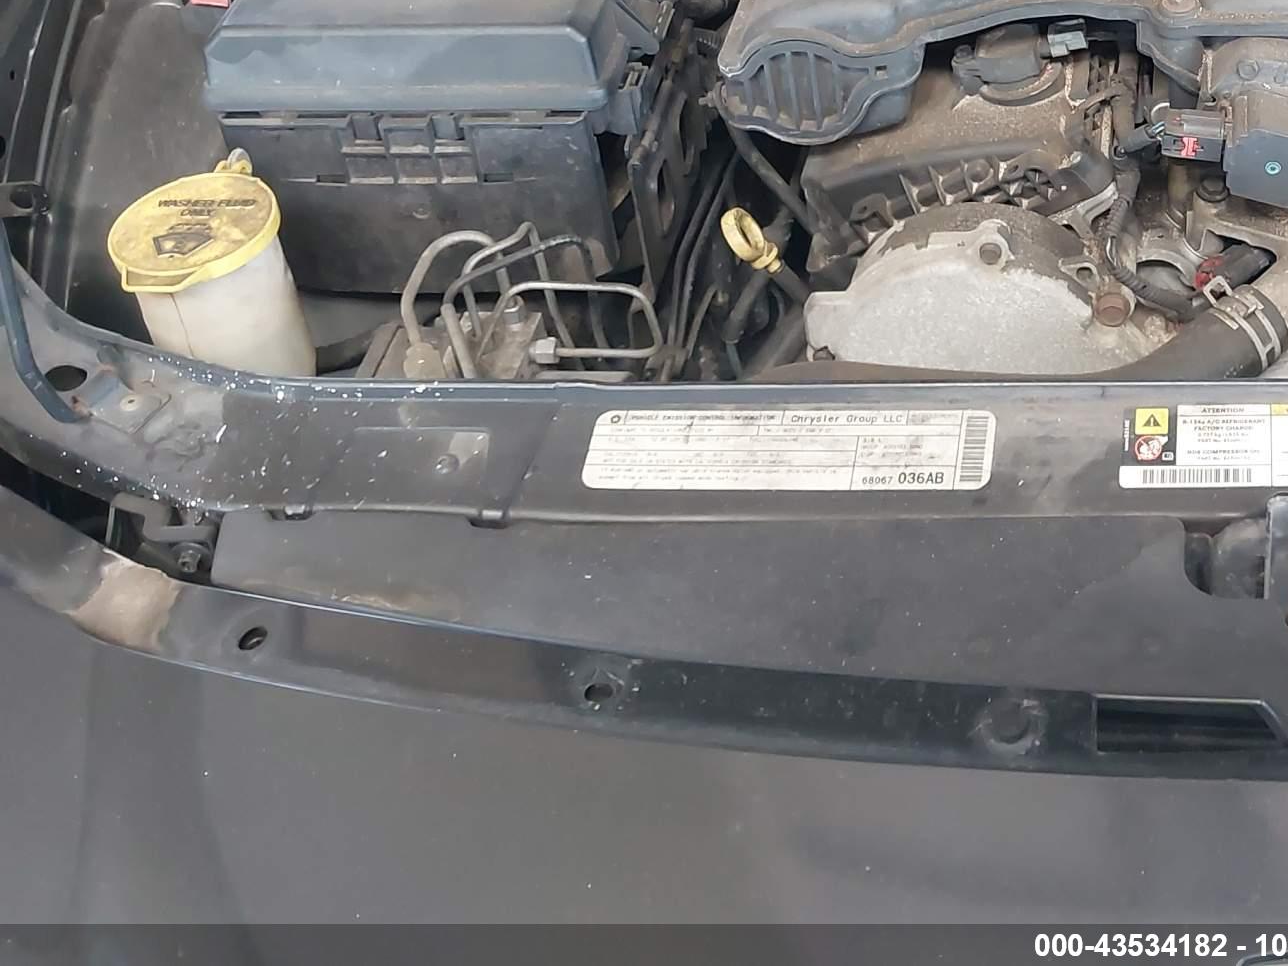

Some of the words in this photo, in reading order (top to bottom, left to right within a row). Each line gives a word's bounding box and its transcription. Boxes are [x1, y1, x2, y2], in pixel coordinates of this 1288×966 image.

[158, 199, 216, 208] WASHER
[217, 198, 257, 208] FLUID
[180, 209, 217, 217] ONLY
[791, 414, 839, 425] Chrysler
[846, 415, 878, 425] Group
[883, 415, 903, 423] LLC
[862, 476, 893, 485] 68067
[898, 472, 944, 485] 036AB
